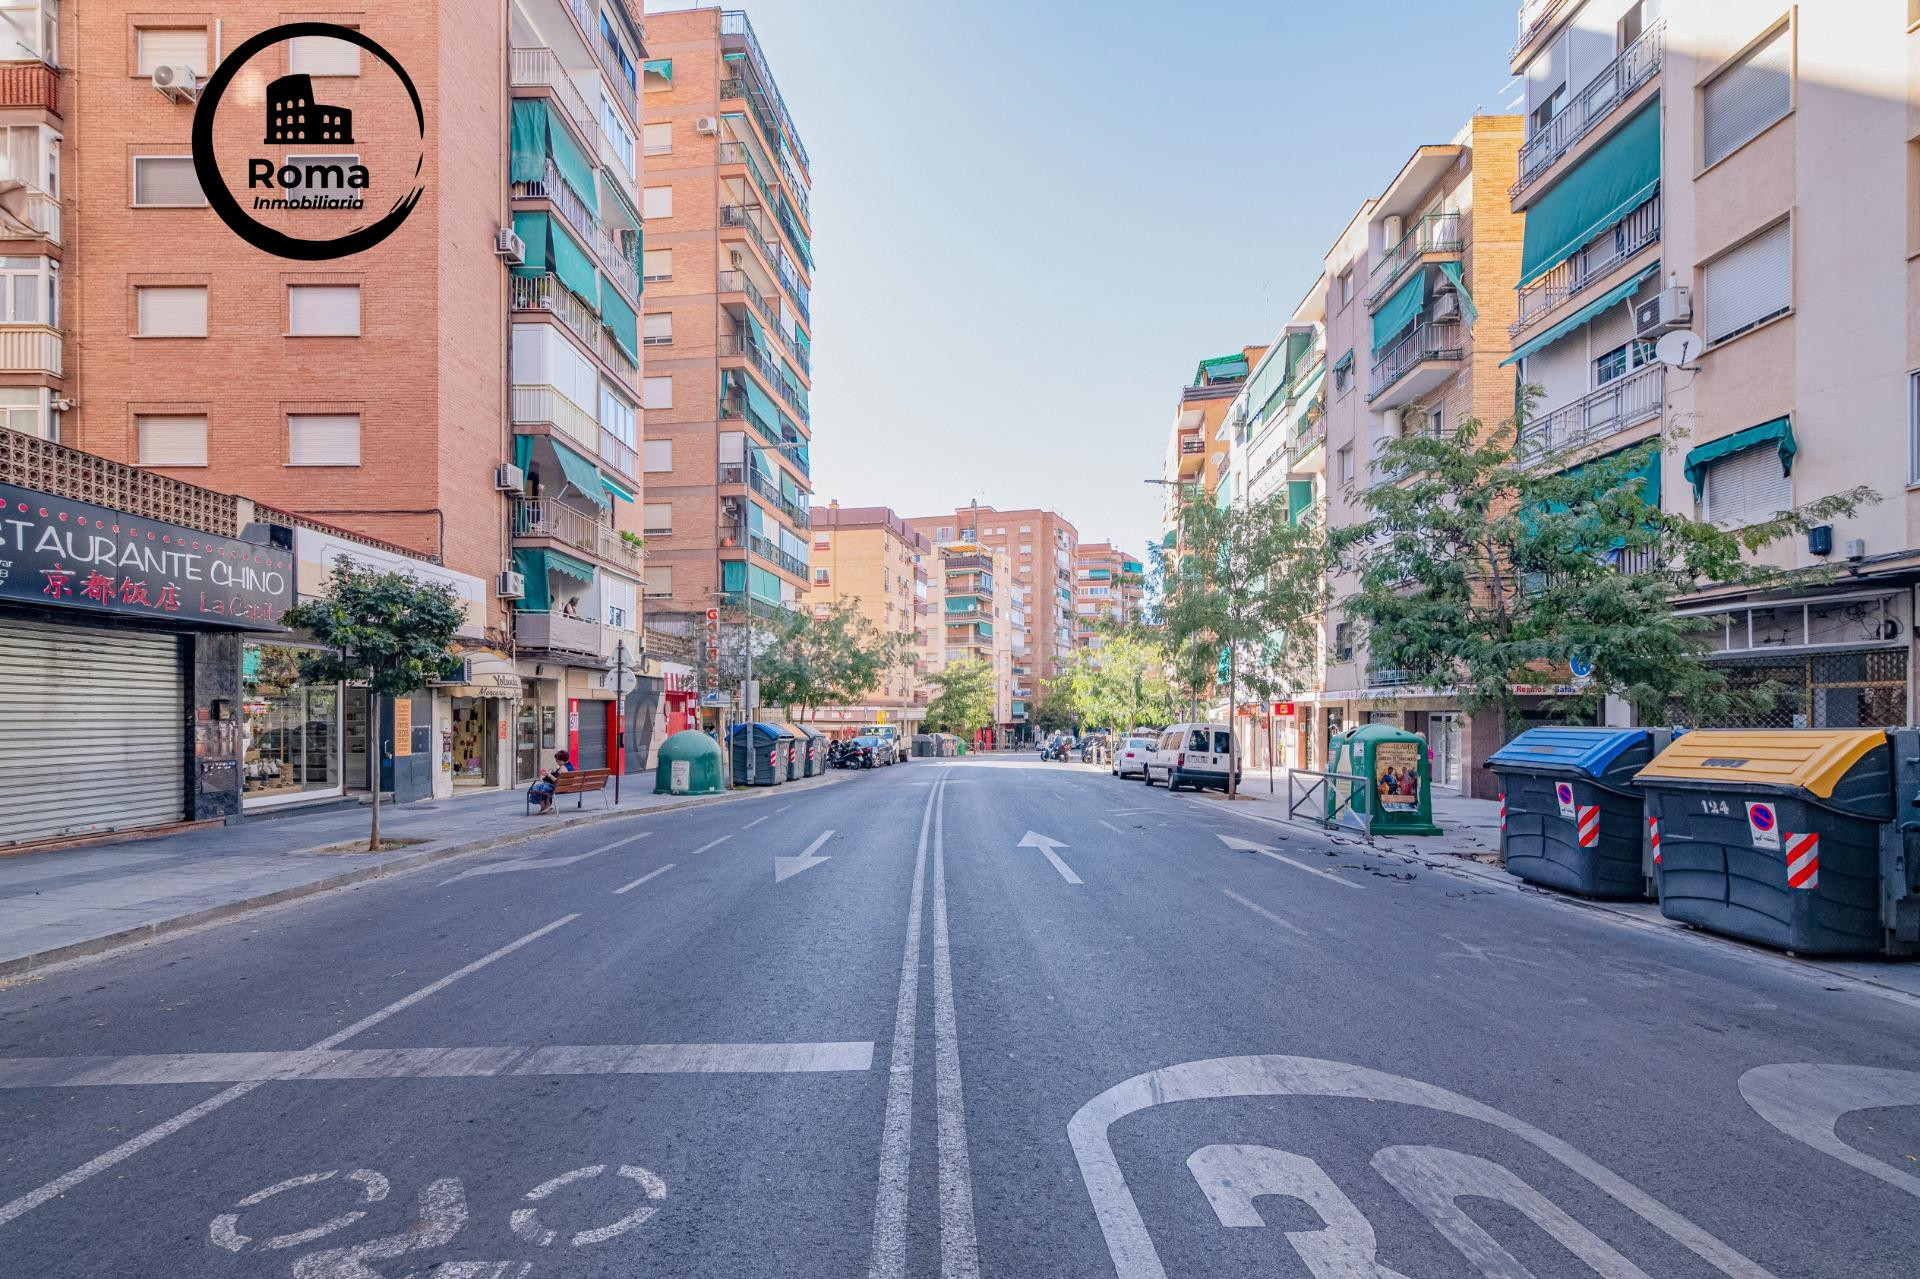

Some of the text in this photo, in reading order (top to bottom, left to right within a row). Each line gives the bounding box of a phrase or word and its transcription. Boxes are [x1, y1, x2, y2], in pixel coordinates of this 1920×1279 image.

[0, 519, 285, 595] TAURANTE CHINO
[39, 563, 181, 612] 京都饭店
[1700, 799, 1730, 815] 124
